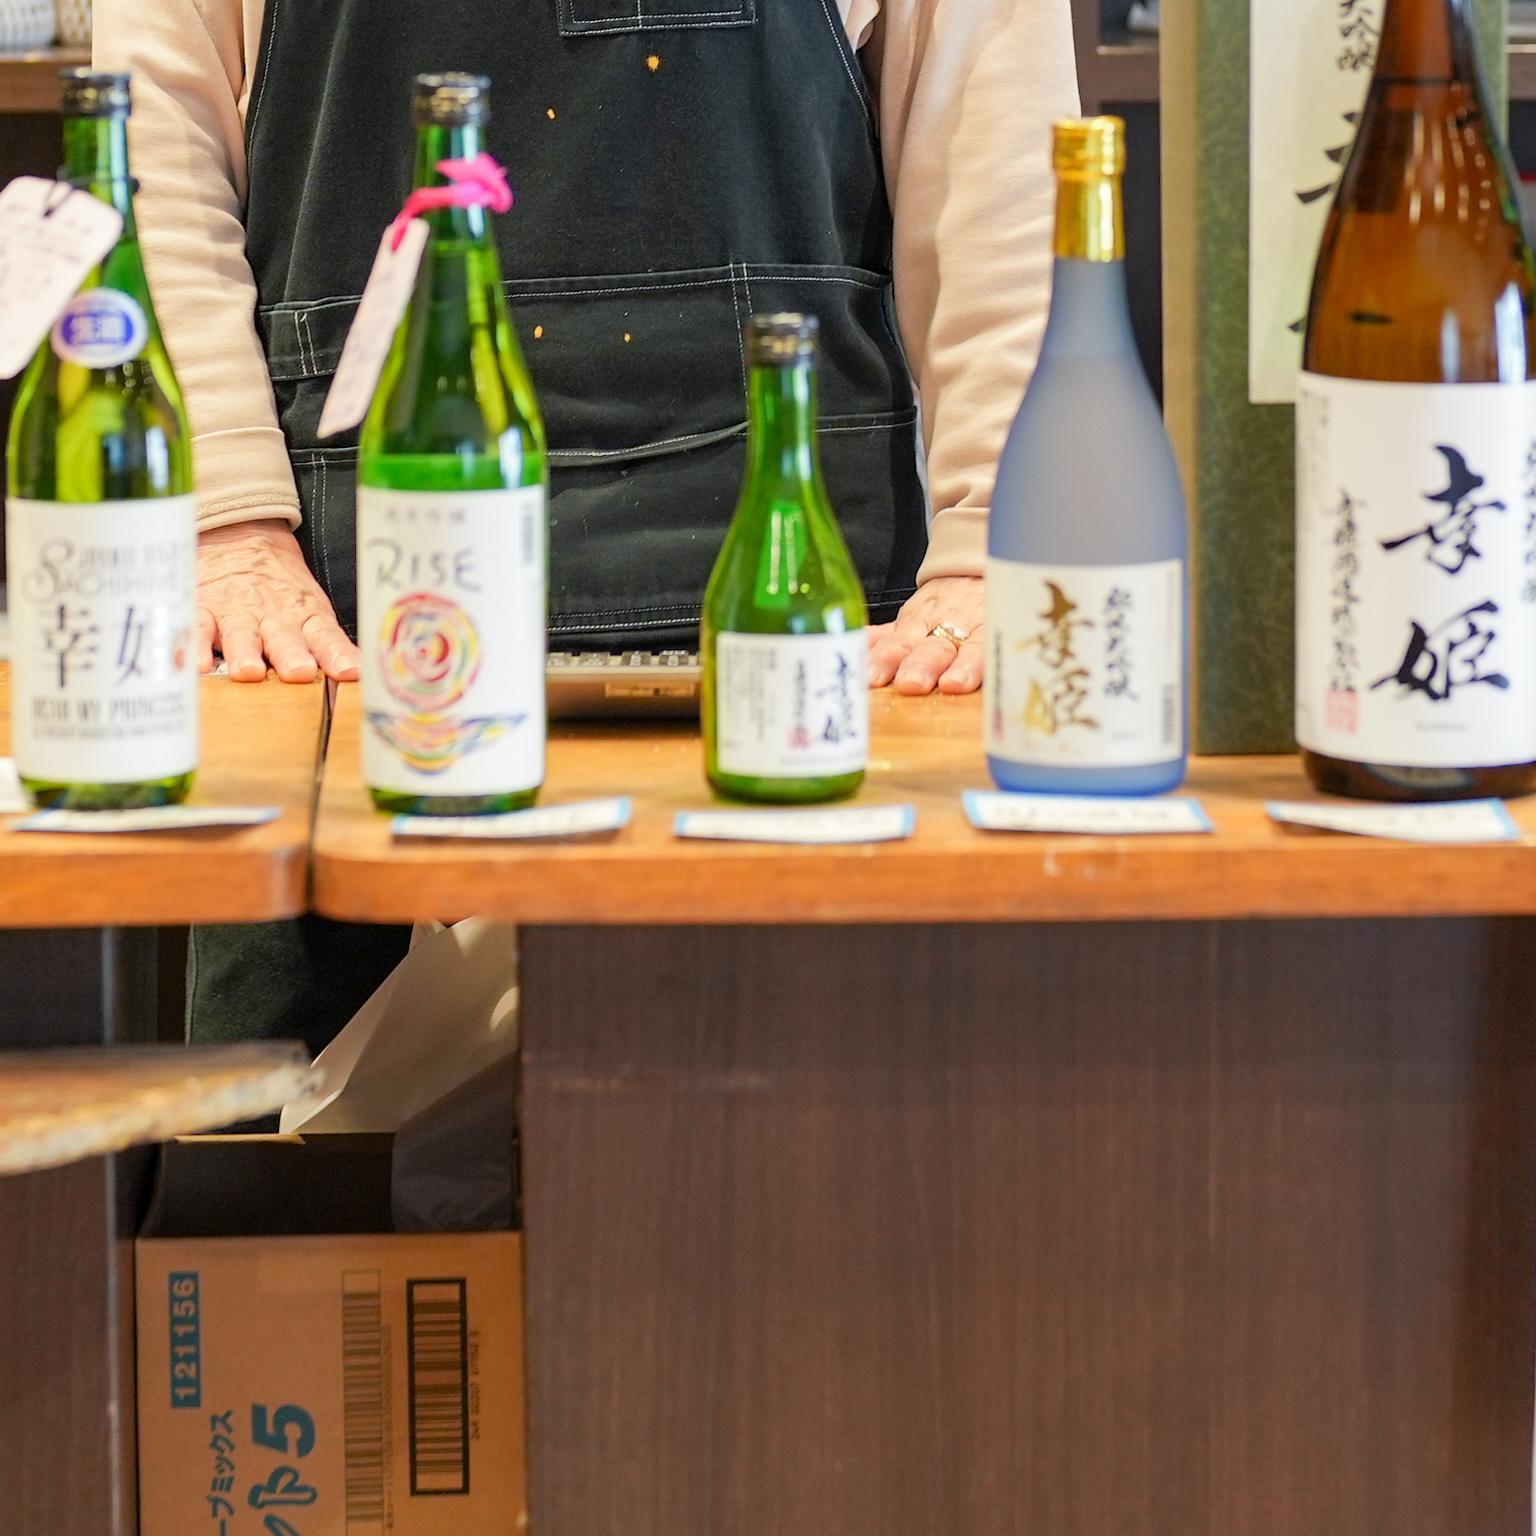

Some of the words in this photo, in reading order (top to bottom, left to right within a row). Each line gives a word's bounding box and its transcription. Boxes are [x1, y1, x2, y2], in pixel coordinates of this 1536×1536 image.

[367, 537, 484, 595] RISE
[1369, 444, 1510, 700] 幸姫
[172, 1277, 199, 1403] 121156
